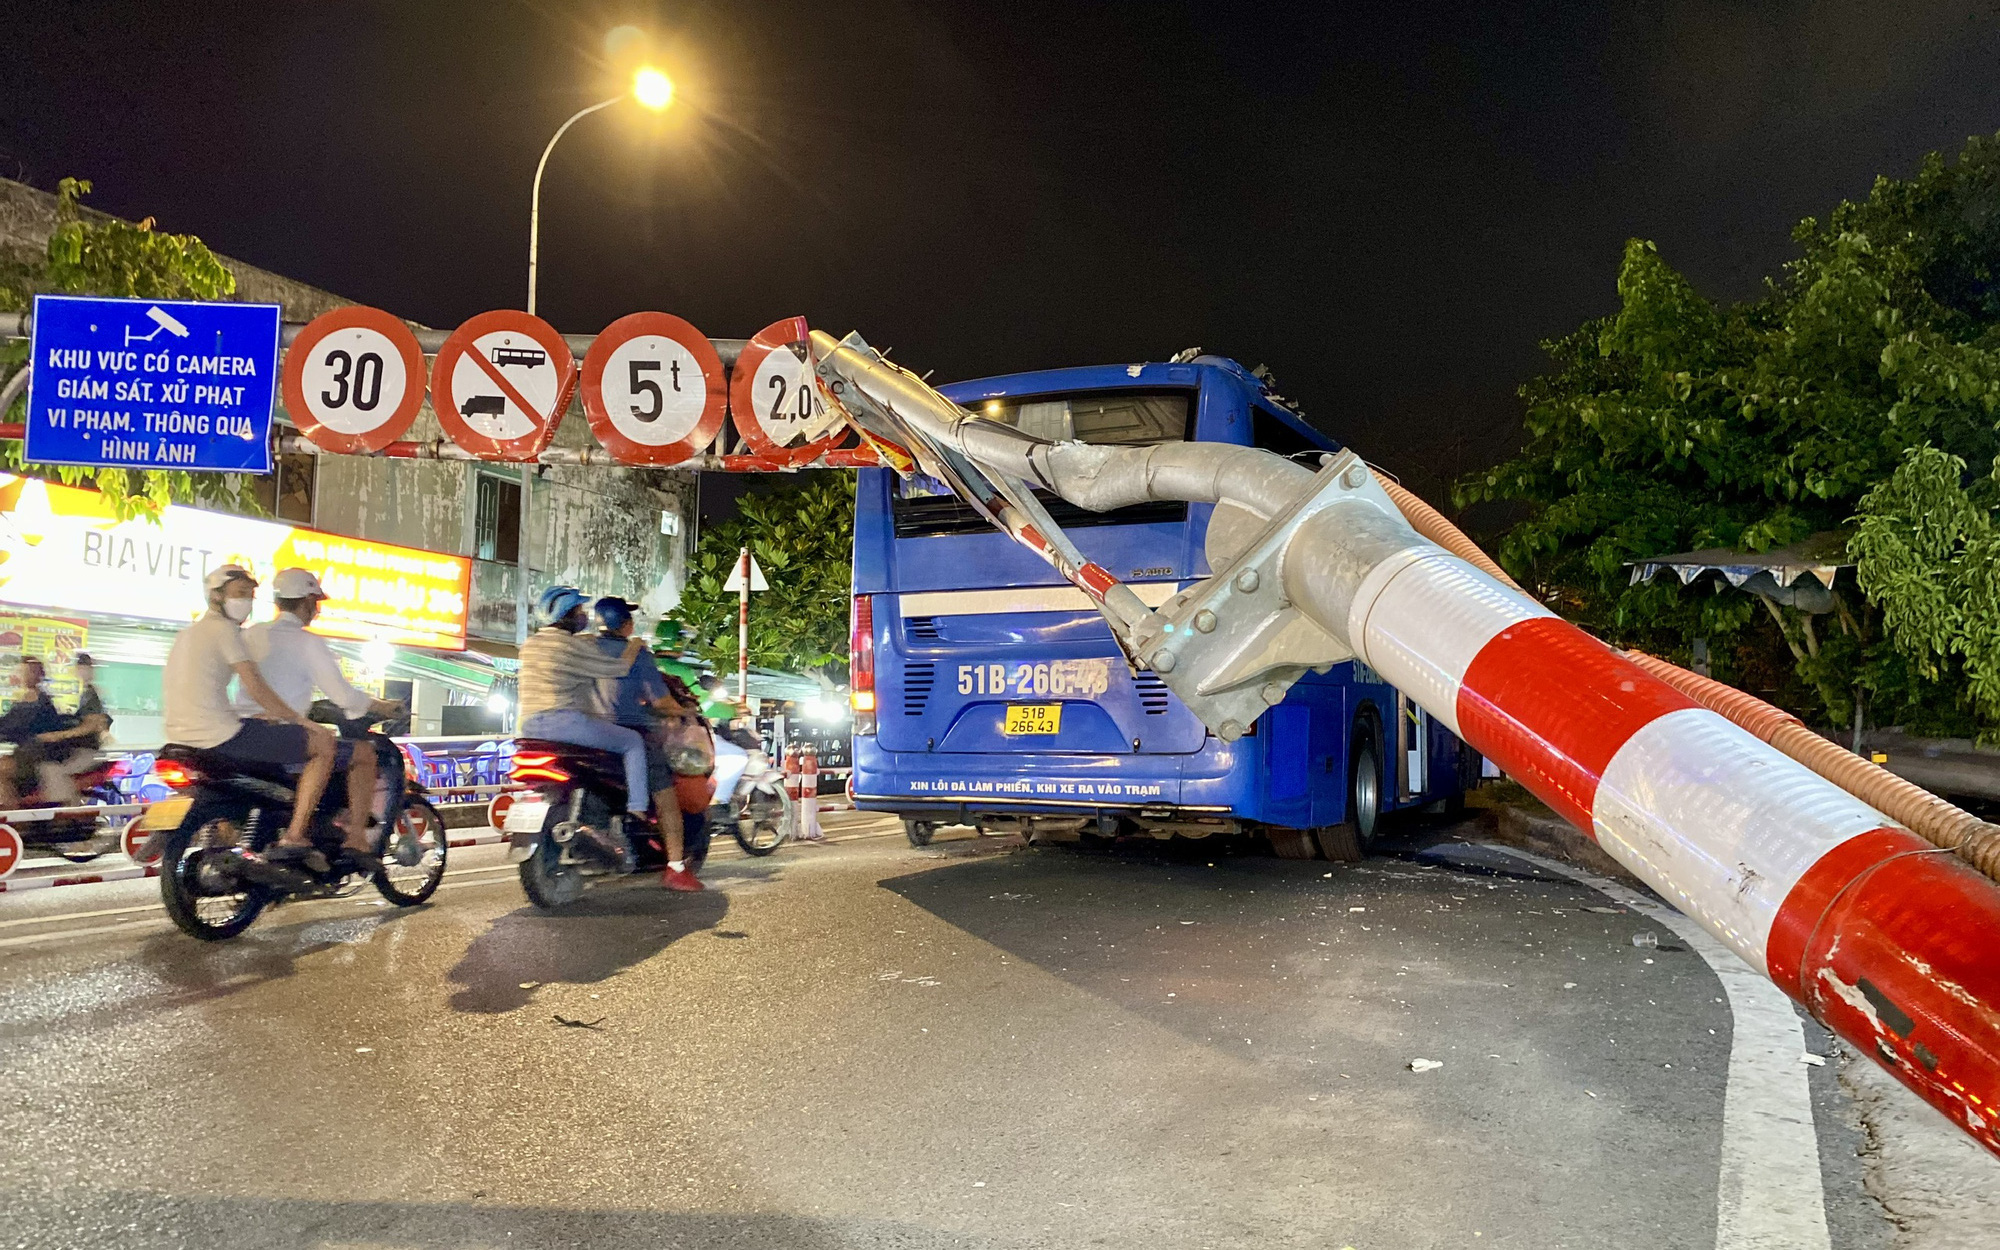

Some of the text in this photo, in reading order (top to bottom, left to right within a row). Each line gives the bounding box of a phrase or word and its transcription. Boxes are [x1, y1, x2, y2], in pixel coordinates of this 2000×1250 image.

[49, 348, 256, 377] KHU VỰC CÓ CAMERA
[57, 374, 108, 400] GIÁM
[160, 378, 189, 404] XỬ
[194, 385, 245, 409] PHẠT
[321, 350, 385, 412] 30
[47, 408, 67, 428] VI
[143, 410, 210, 435] THÔNG
[215, 415, 253, 437] QUA
[101, 435, 196, 464] HÌNH ẢNH
[83, 531, 136, 573] BIA
[957, 663, 1108, 695] 51B-266.43
[1011, 720, 1054, 733] 266.43
[1022, 707, 1045, 719] 51B
[910, 781, 929, 791] XIN
[951, 780, 966, 792] ĐÃ
[968, 780, 993, 793] LÀM
[1036, 783, 1057, 794] KHI
[1059, 784, 1075, 794] XE
[1078, 784, 1095, 795] RA
[1097, 783, 1122, 795] VÀO
[1124, 785, 1161, 797] TRẠM
